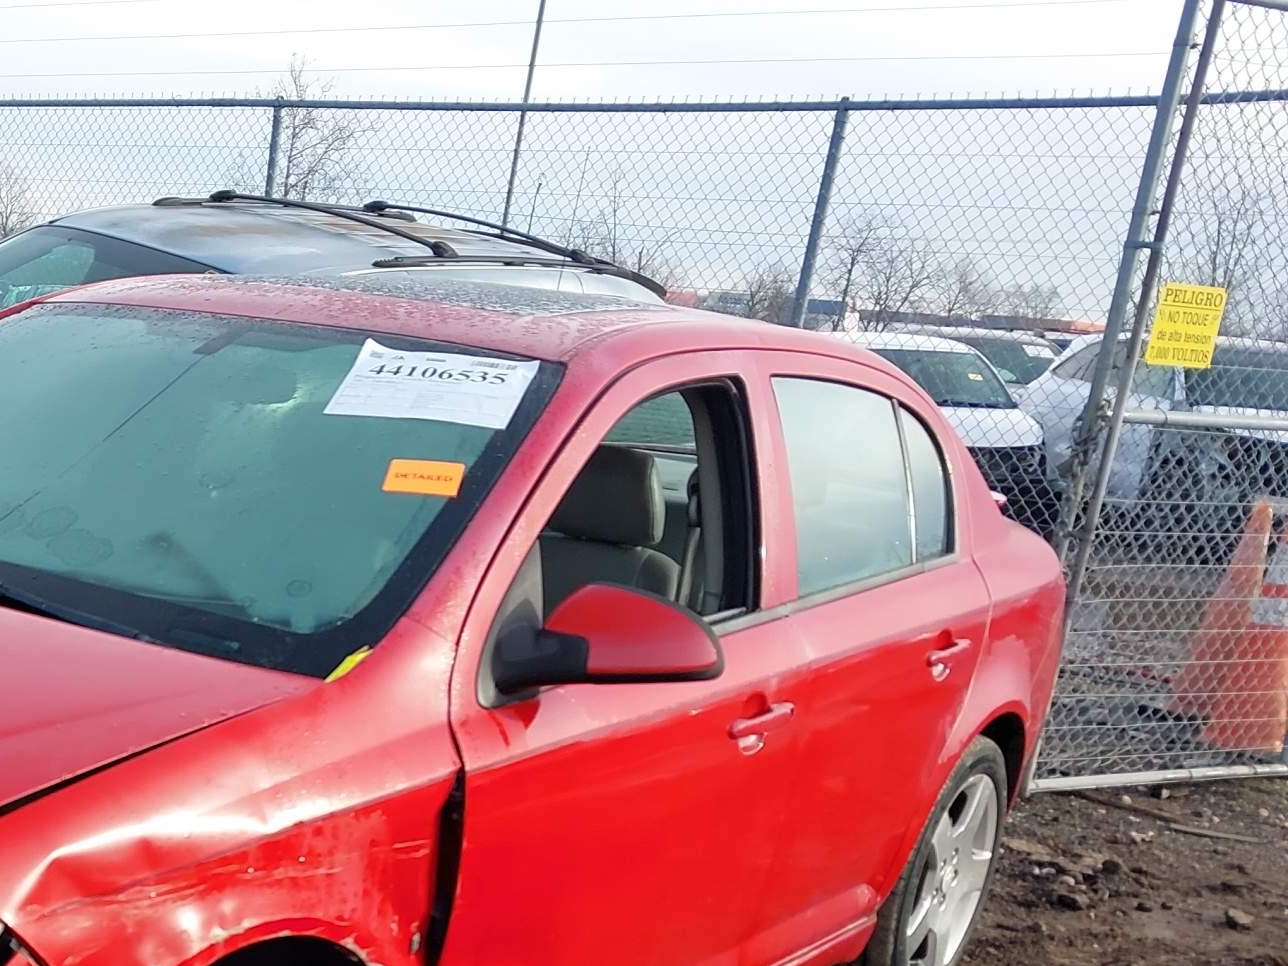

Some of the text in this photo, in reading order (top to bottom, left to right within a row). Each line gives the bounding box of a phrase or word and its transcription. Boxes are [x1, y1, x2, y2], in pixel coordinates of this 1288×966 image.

[1163, 288, 1223, 307] PELIGRO
[1168, 310, 1210, 327] NO TOQUE
[1172, 347, 1210, 364] VOLTIOS
[368, 363, 510, 386] 44106535
